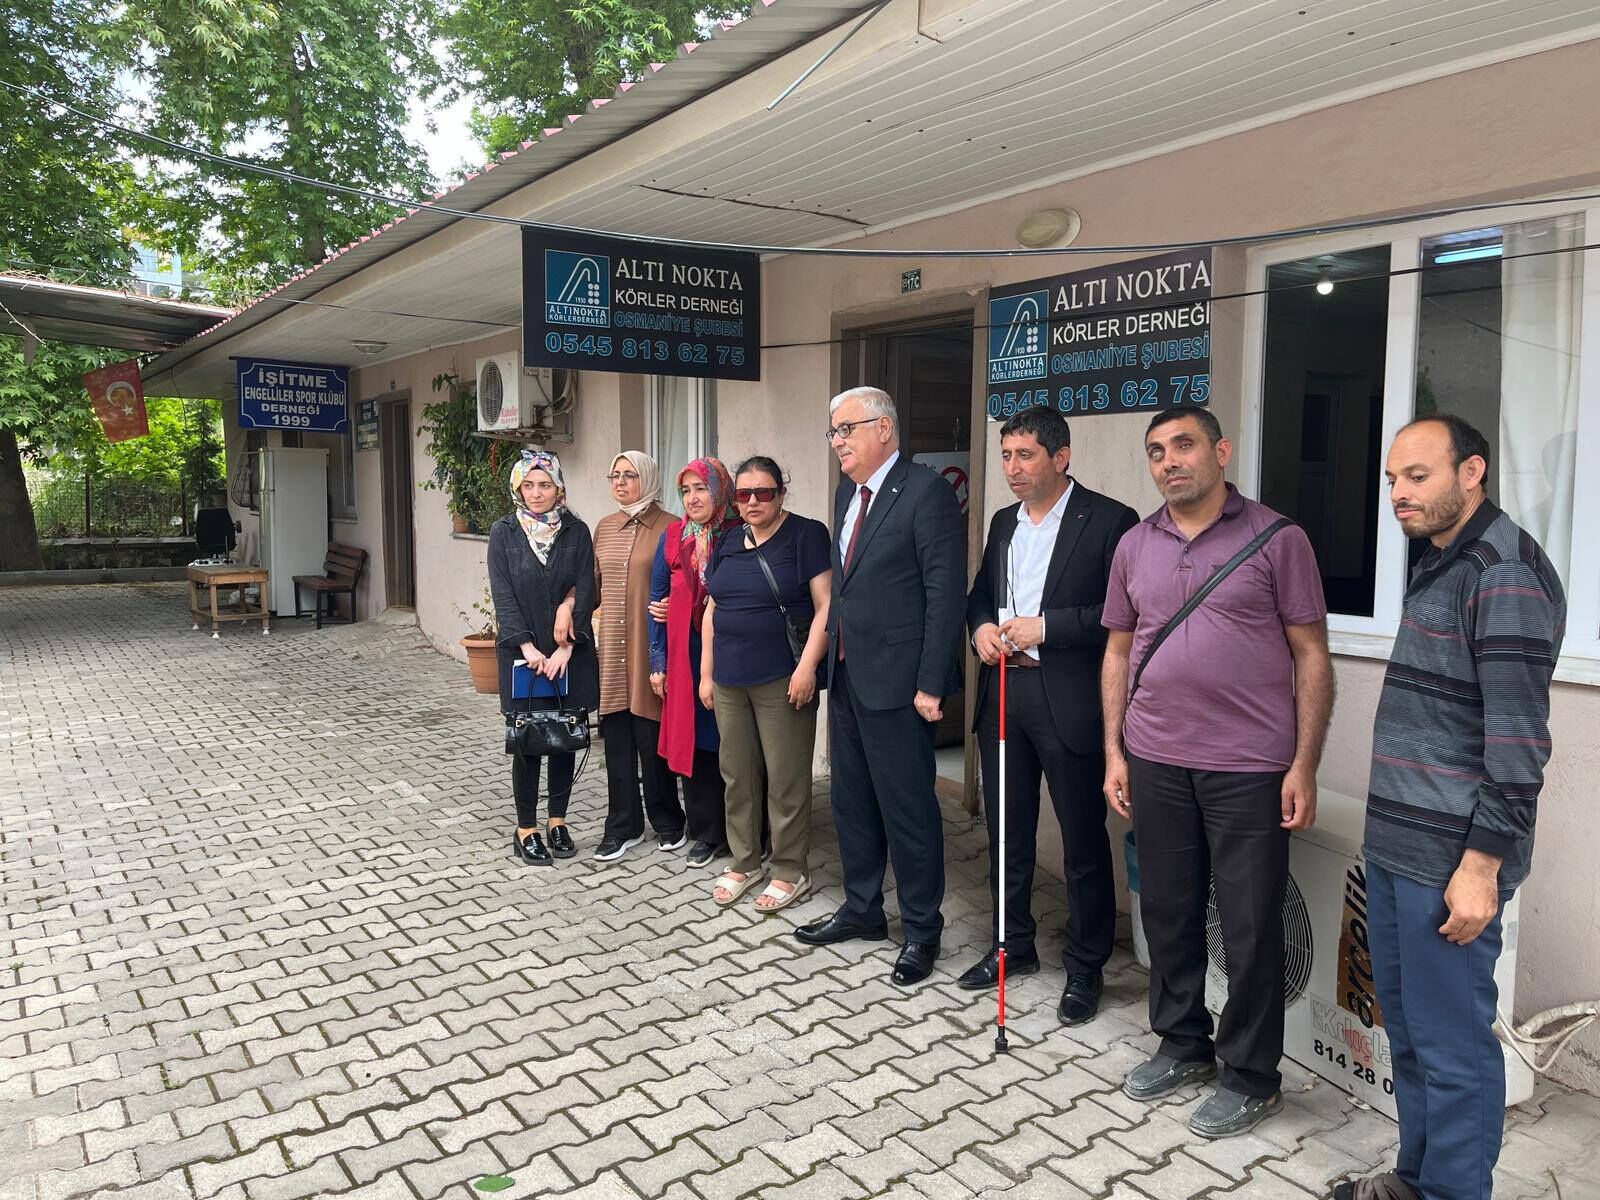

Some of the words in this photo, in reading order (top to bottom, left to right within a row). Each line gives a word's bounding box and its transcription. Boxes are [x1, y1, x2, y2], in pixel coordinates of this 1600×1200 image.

[615, 257, 664, 282] ALTI
[672, 264, 743, 291] NOKTA
[1053, 278, 1107, 313] ALTI
[1116, 259, 1211, 302] NOKTA
[549, 304, 607, 318] ALTINOKTA
[615, 288, 676, 309] KÖRLER
[680, 296, 743, 316] DERNEĞİ
[614, 310, 691, 333] OSMANİYE
[694, 318, 743, 337] ŞUBESİ
[1053, 318, 1120, 345] KÖRLER
[1125, 301, 1210, 335] DERNEĞİ
[545, 331, 613, 357] 0545
[622, 338, 669, 360] 813
[678, 343, 708, 364] 62
[716, 346, 745, 366] 75
[1051, 344, 1137, 374] OSMANİYE
[1141, 331, 1209, 369] ŞUBESİ
[258, 368, 328, 388] İŞİTME
[992, 357, 1044, 373] ALTINOKTA
[245, 386, 294, 403] ENGELLİLER
[295, 390, 317, 404] SPOR
[318, 391, 344, 406] KLÜBÜ
[261, 403, 320, 415] DERNEĞİ
[988, 389, 1049, 418] 0545
[1059, 383, 1110, 412] 813
[1120, 378, 1158, 407] 62
[1170, 374, 1210, 404] 75
[272, 415, 310, 427] 1999
[1314, 1039, 1347, 1069] 814
[1353, 1061, 1376, 1085] 28
